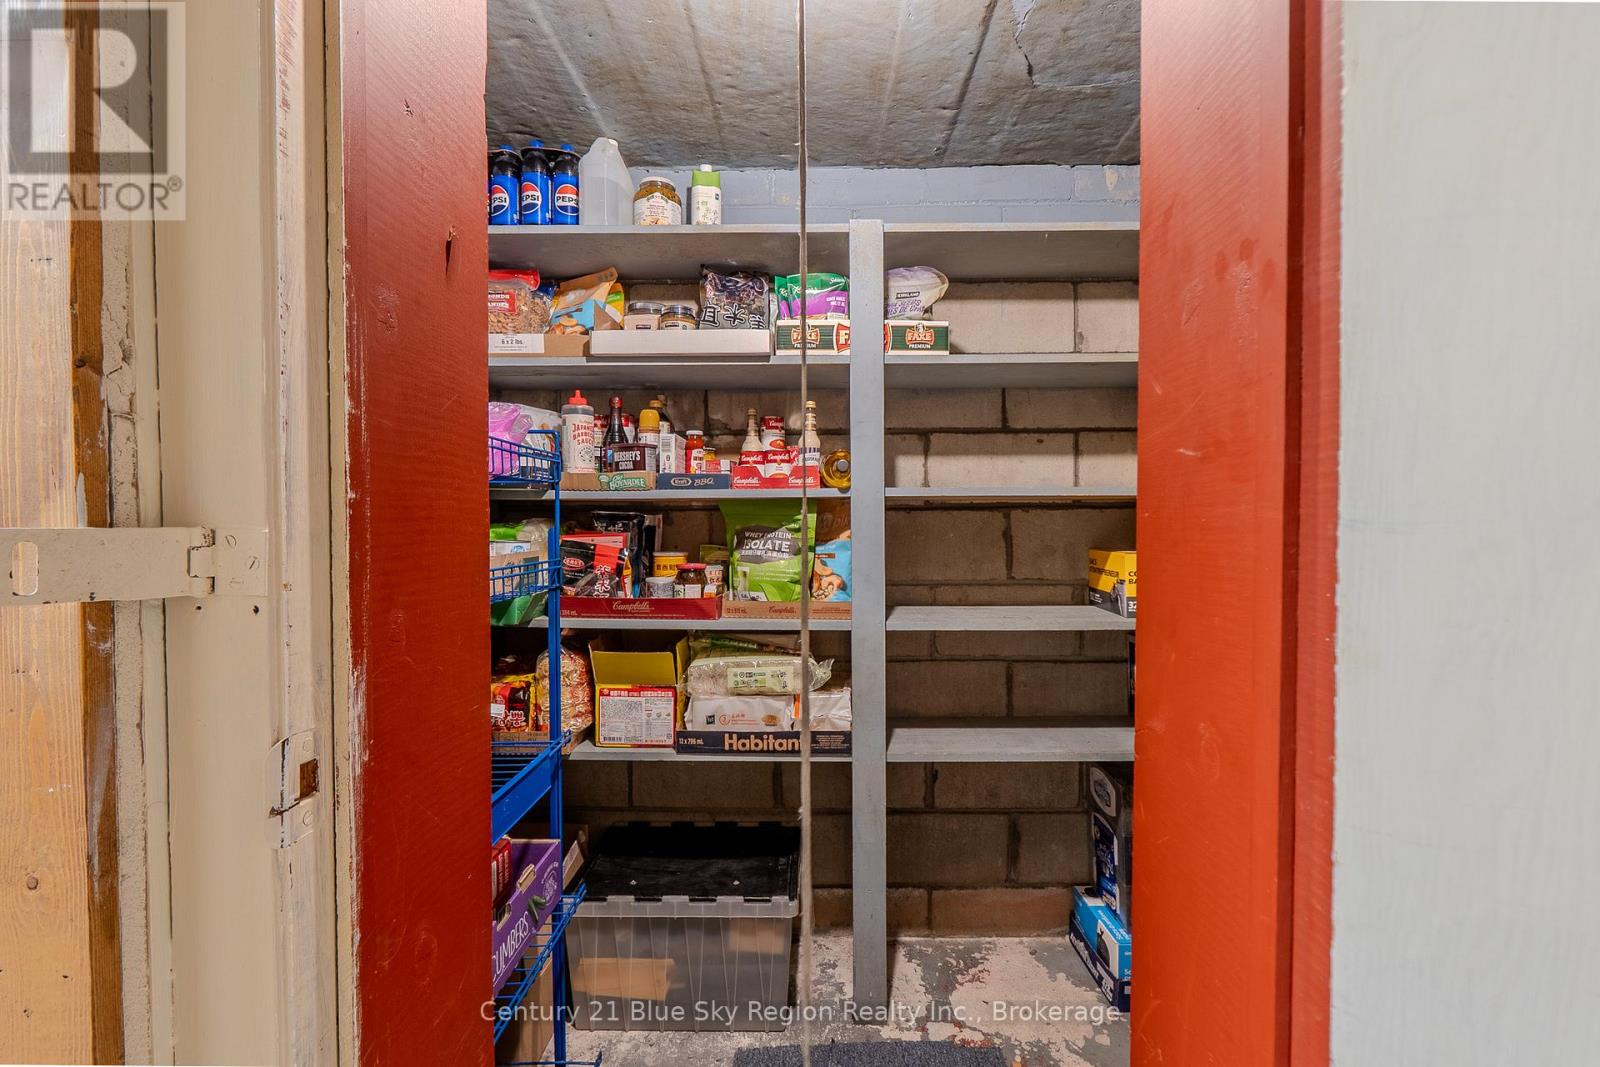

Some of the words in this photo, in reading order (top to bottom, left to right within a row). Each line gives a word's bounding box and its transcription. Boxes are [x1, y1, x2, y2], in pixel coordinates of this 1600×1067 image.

[907, 332, 932, 343] FAXE
[614, 451, 641, 461] HERSHEY'S
[619, 461, 633, 469] COCOA
[609, 478, 646, 490] BOYARDEE
[693, 478, 714, 487] BBQ
[745, 531, 763, 539] WHEY
[743, 539, 790, 552] ISOLATE
[724, 733, 801, 751] Habitan
